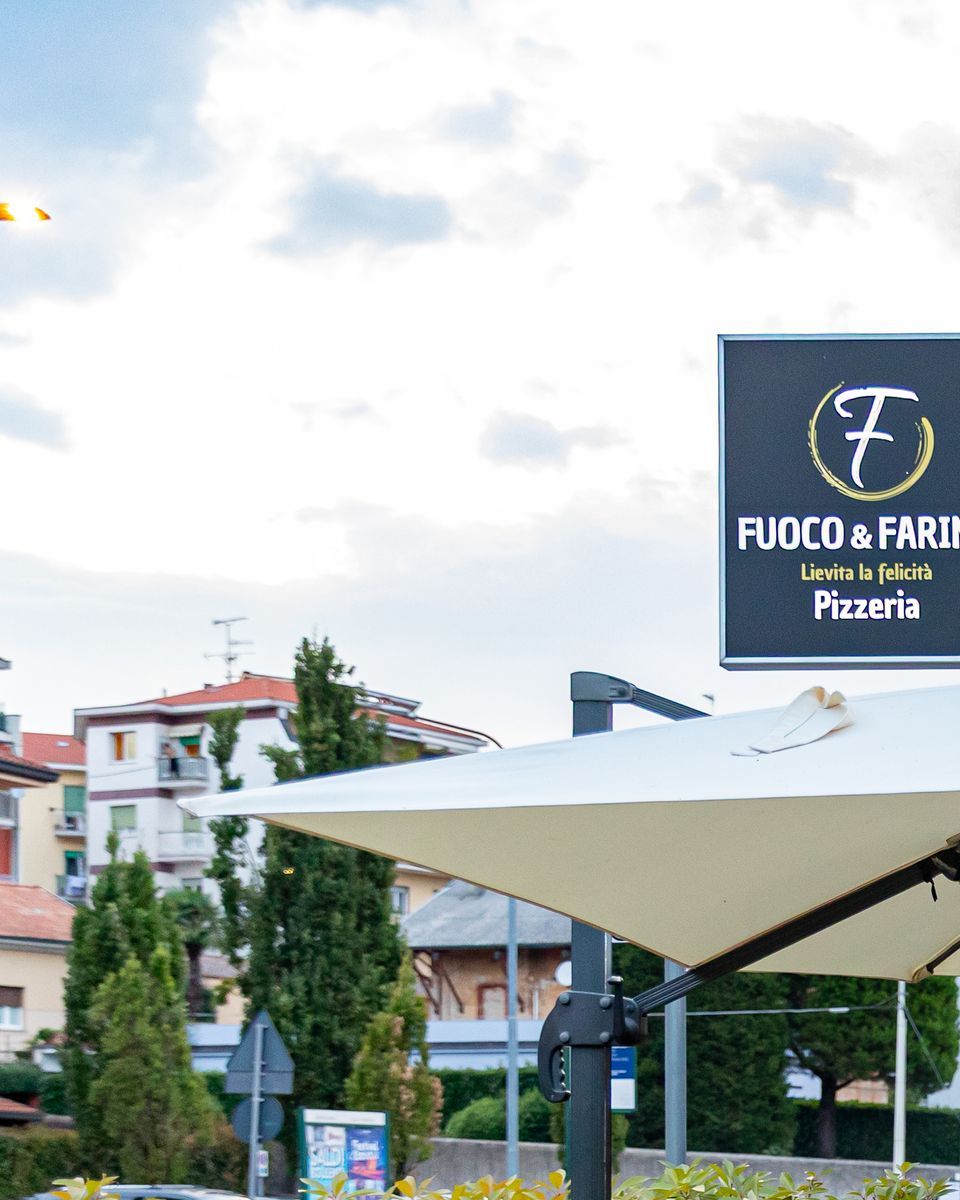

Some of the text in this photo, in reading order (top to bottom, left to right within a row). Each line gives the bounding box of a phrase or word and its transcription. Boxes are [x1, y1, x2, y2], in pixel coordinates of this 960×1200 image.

[834, 385, 919, 488] F
[738, 515, 844, 550] FUOCO
[850, 523, 872, 549] &
[801, 562, 933, 585] Lievita la felicità
[814, 589, 920, 620] Pizzeria
